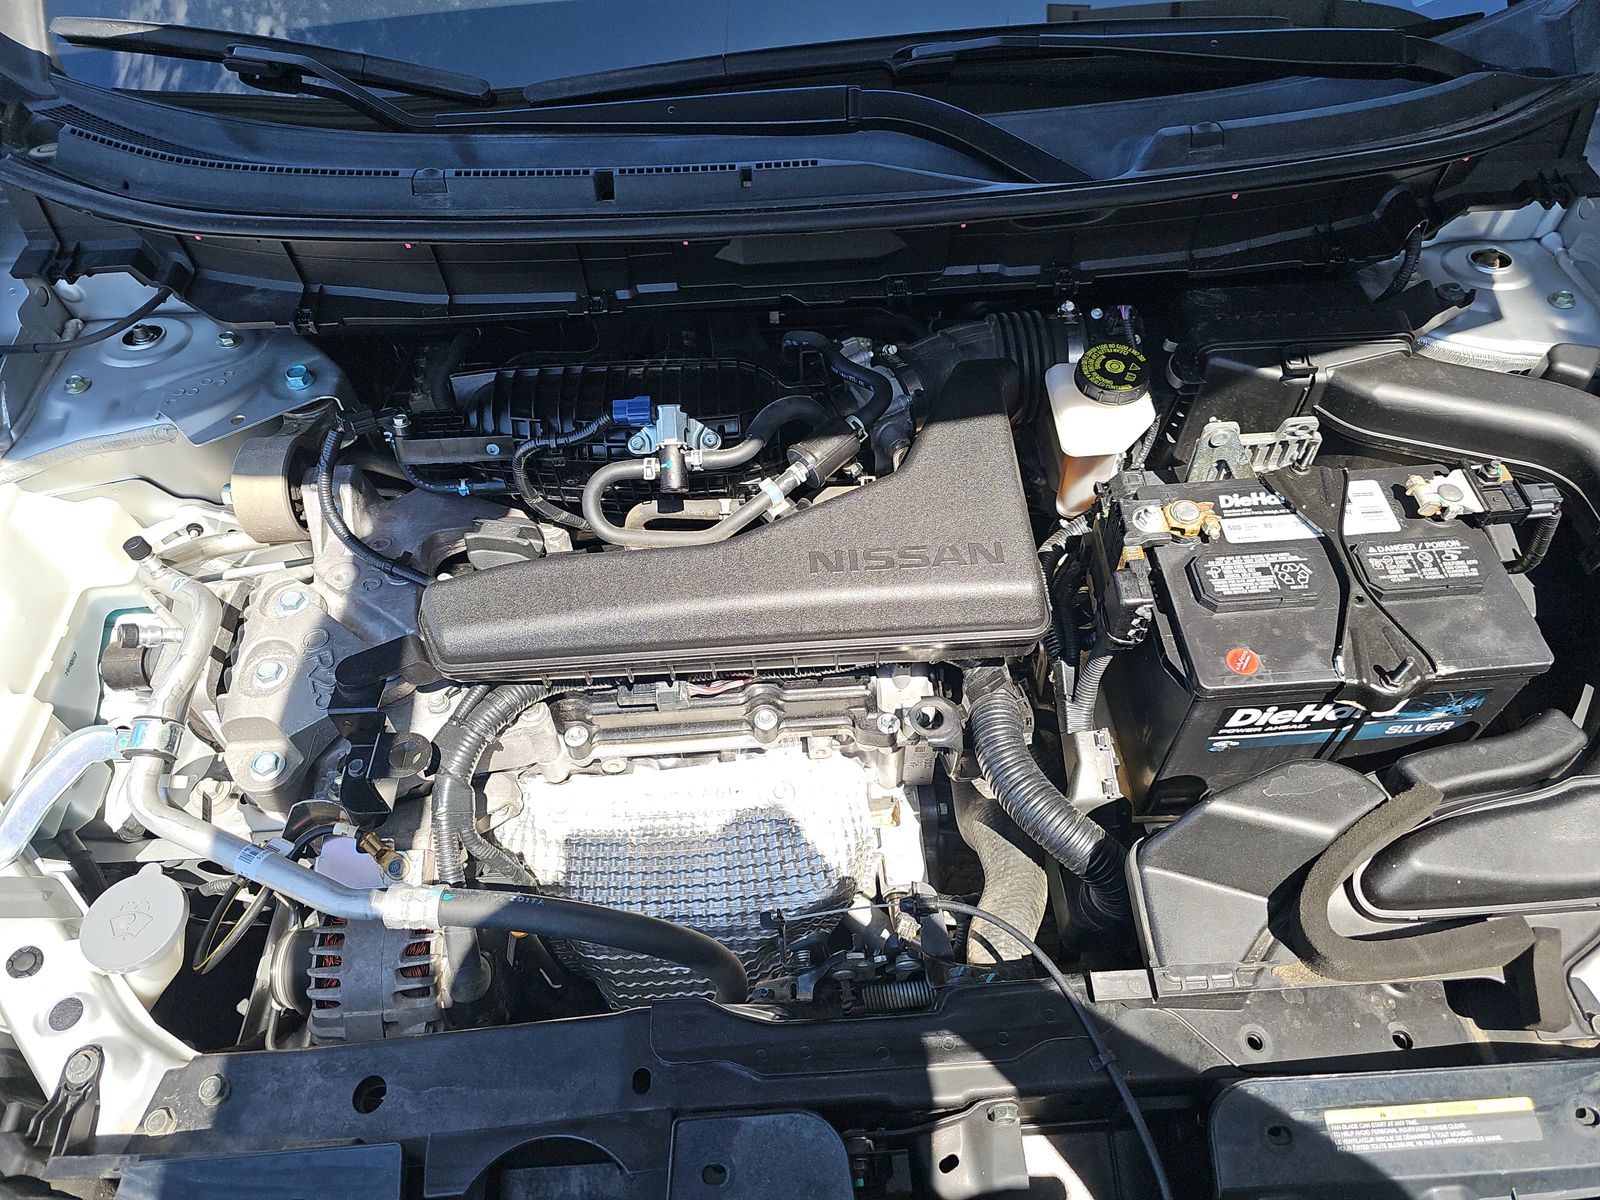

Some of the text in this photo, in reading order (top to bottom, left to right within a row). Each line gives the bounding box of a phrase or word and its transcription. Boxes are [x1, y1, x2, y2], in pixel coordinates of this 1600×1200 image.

[1219, 492, 1284, 508] DieHa
[1376, 543, 1416, 552] DANGER
[1424, 540, 1461, 549] POISON
[808, 542, 1006, 574] NISSAN
[1264, 724, 1308, 732] AHEAD
[1384, 721, 1455, 735] SILVER
